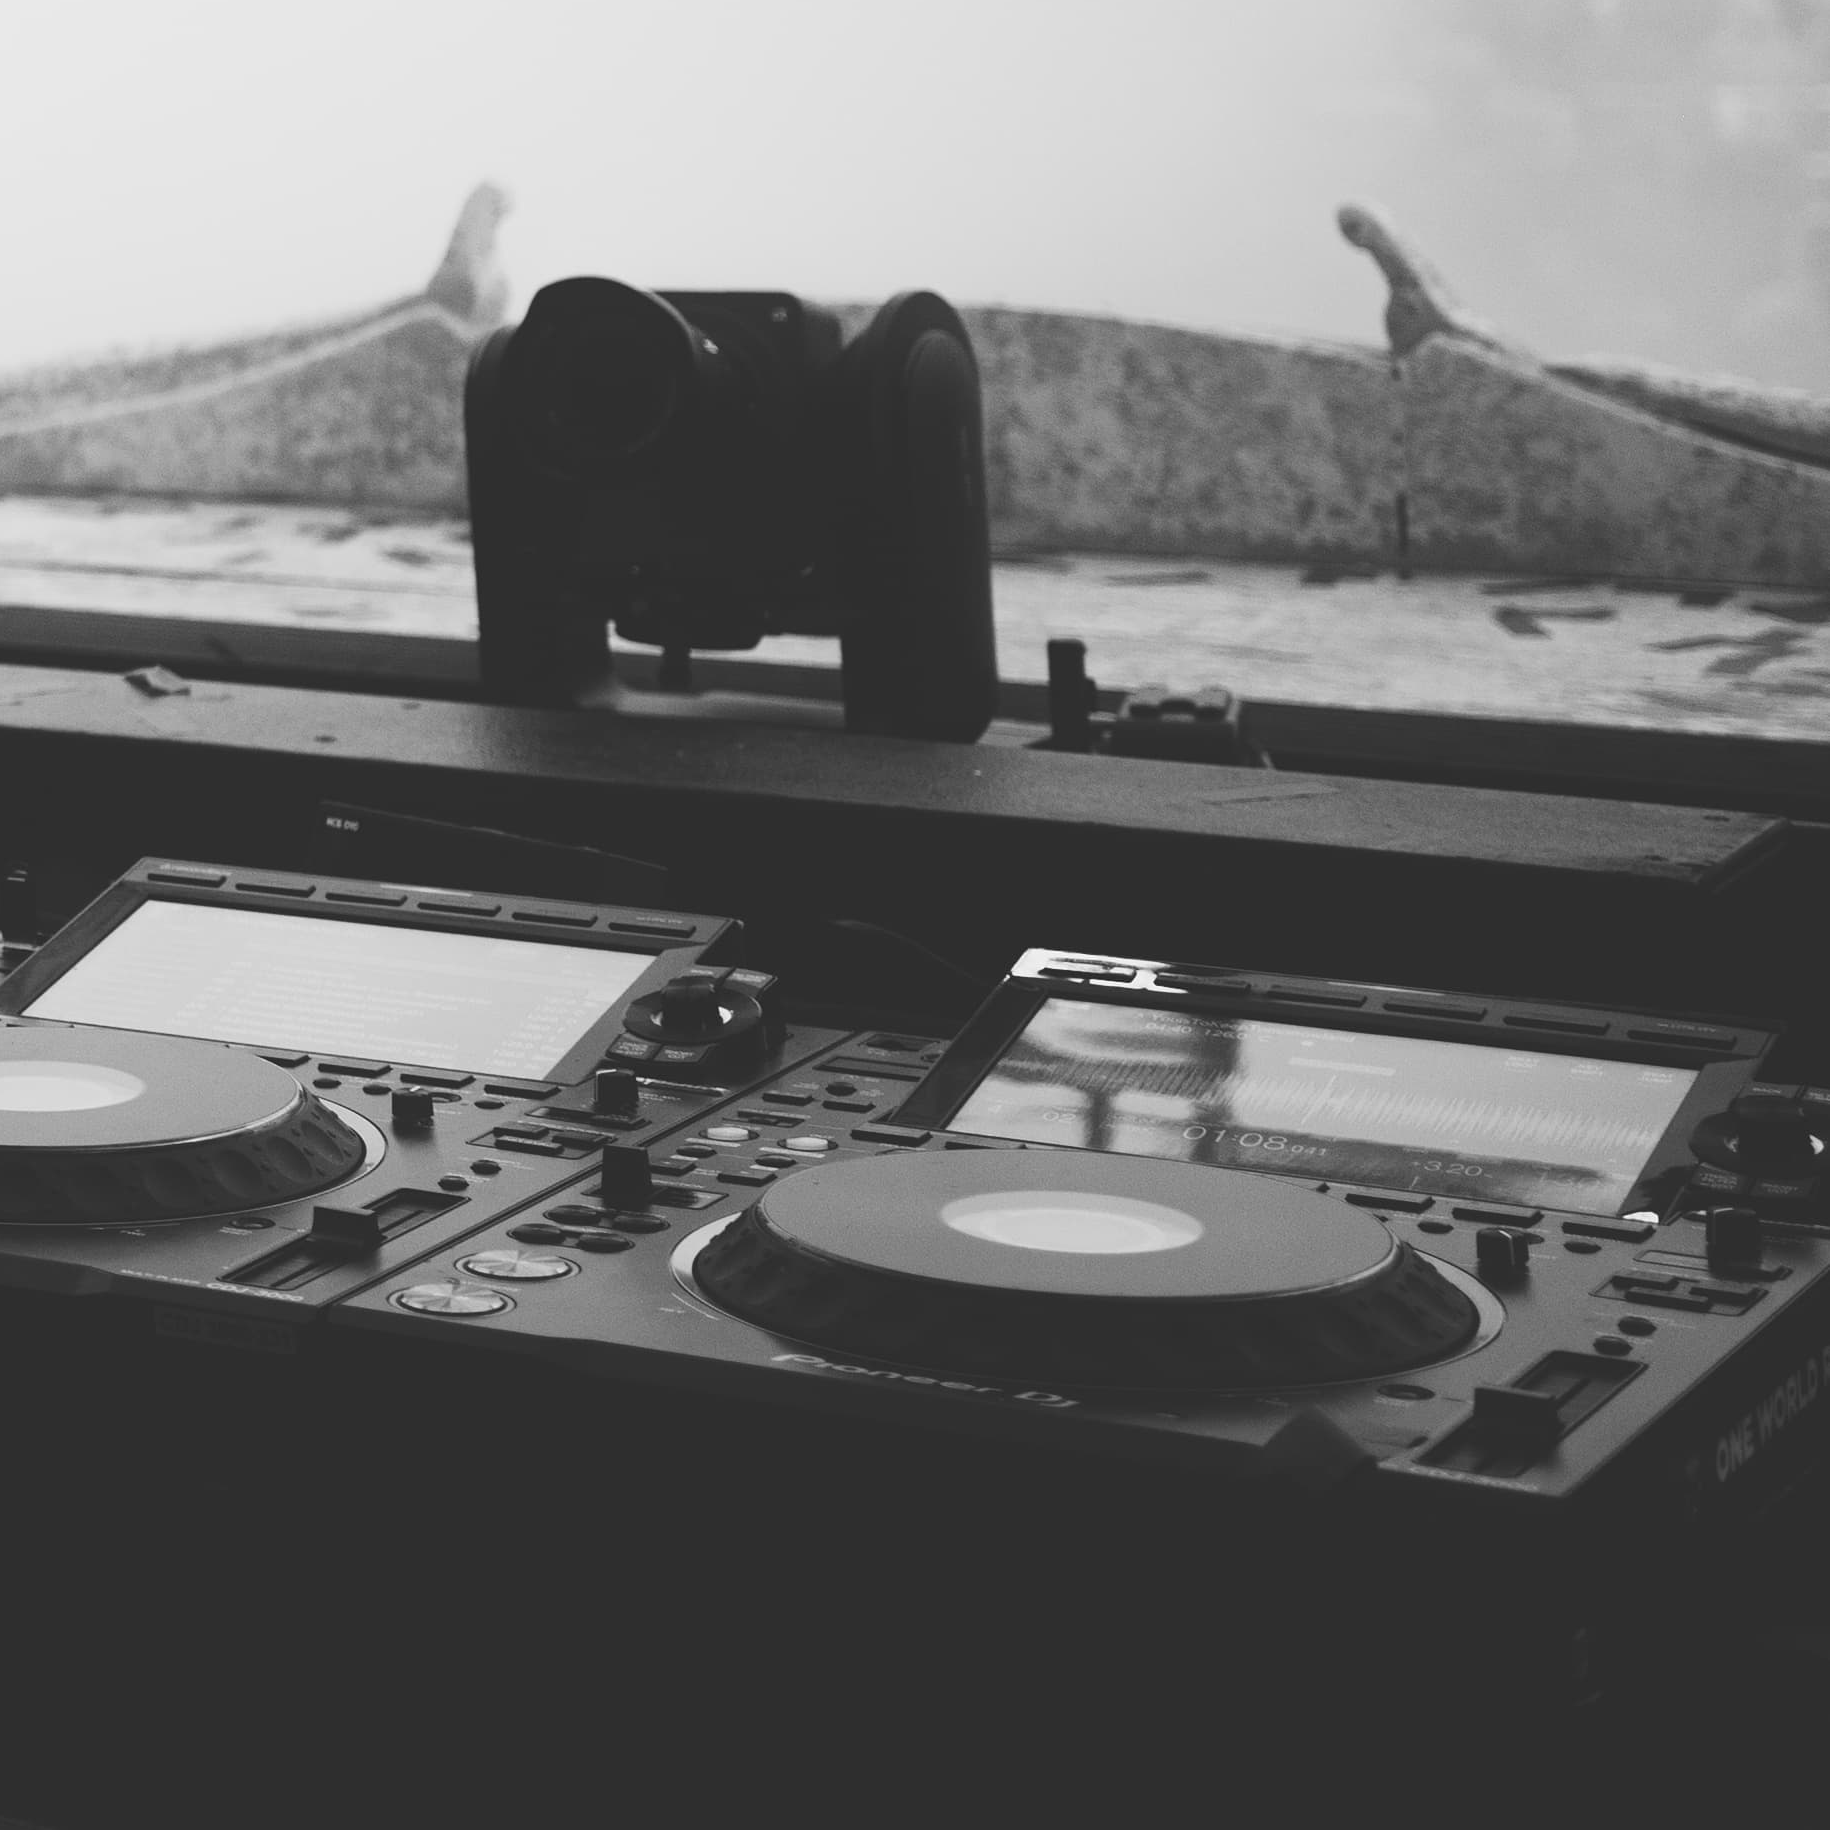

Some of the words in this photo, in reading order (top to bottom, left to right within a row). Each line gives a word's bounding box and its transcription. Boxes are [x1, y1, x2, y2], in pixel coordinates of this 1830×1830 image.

[771, 1354, 1004, 1392] Pioneer
[1012, 1390, 1081, 1407] DJ
[1715, 1413, 1755, 1483] ONE
[1756, 1356, 1819, 1448] WORLD
